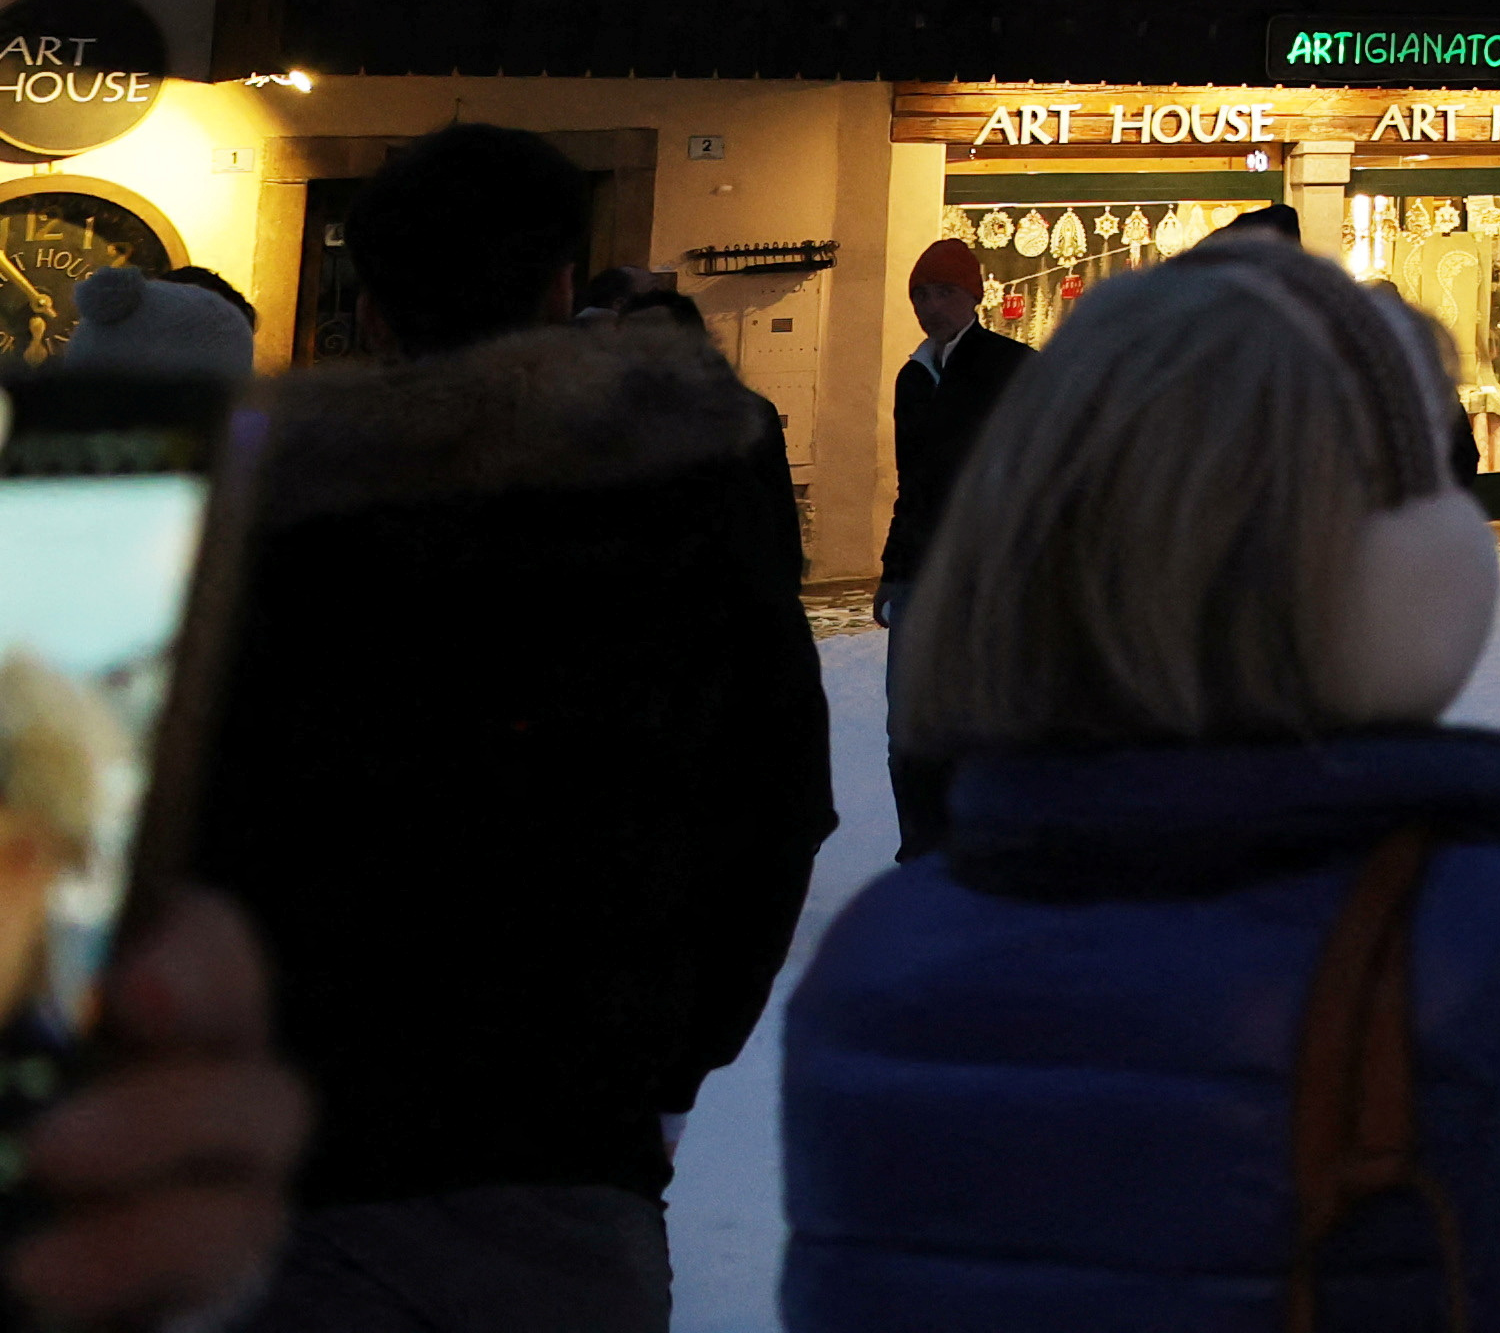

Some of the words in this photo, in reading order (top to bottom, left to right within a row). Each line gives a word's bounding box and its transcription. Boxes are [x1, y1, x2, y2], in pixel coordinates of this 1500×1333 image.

[0, 35, 98, 67] ART
[0, 71, 151, 104] HOUSE
[973, 102, 1082, 145] ART
[1111, 102, 1275, 145] HOUSE
[1370, 103, 1466, 142] ART
[702, 139, 712, 152] 2
[36, 248, 94, 280] HOU
